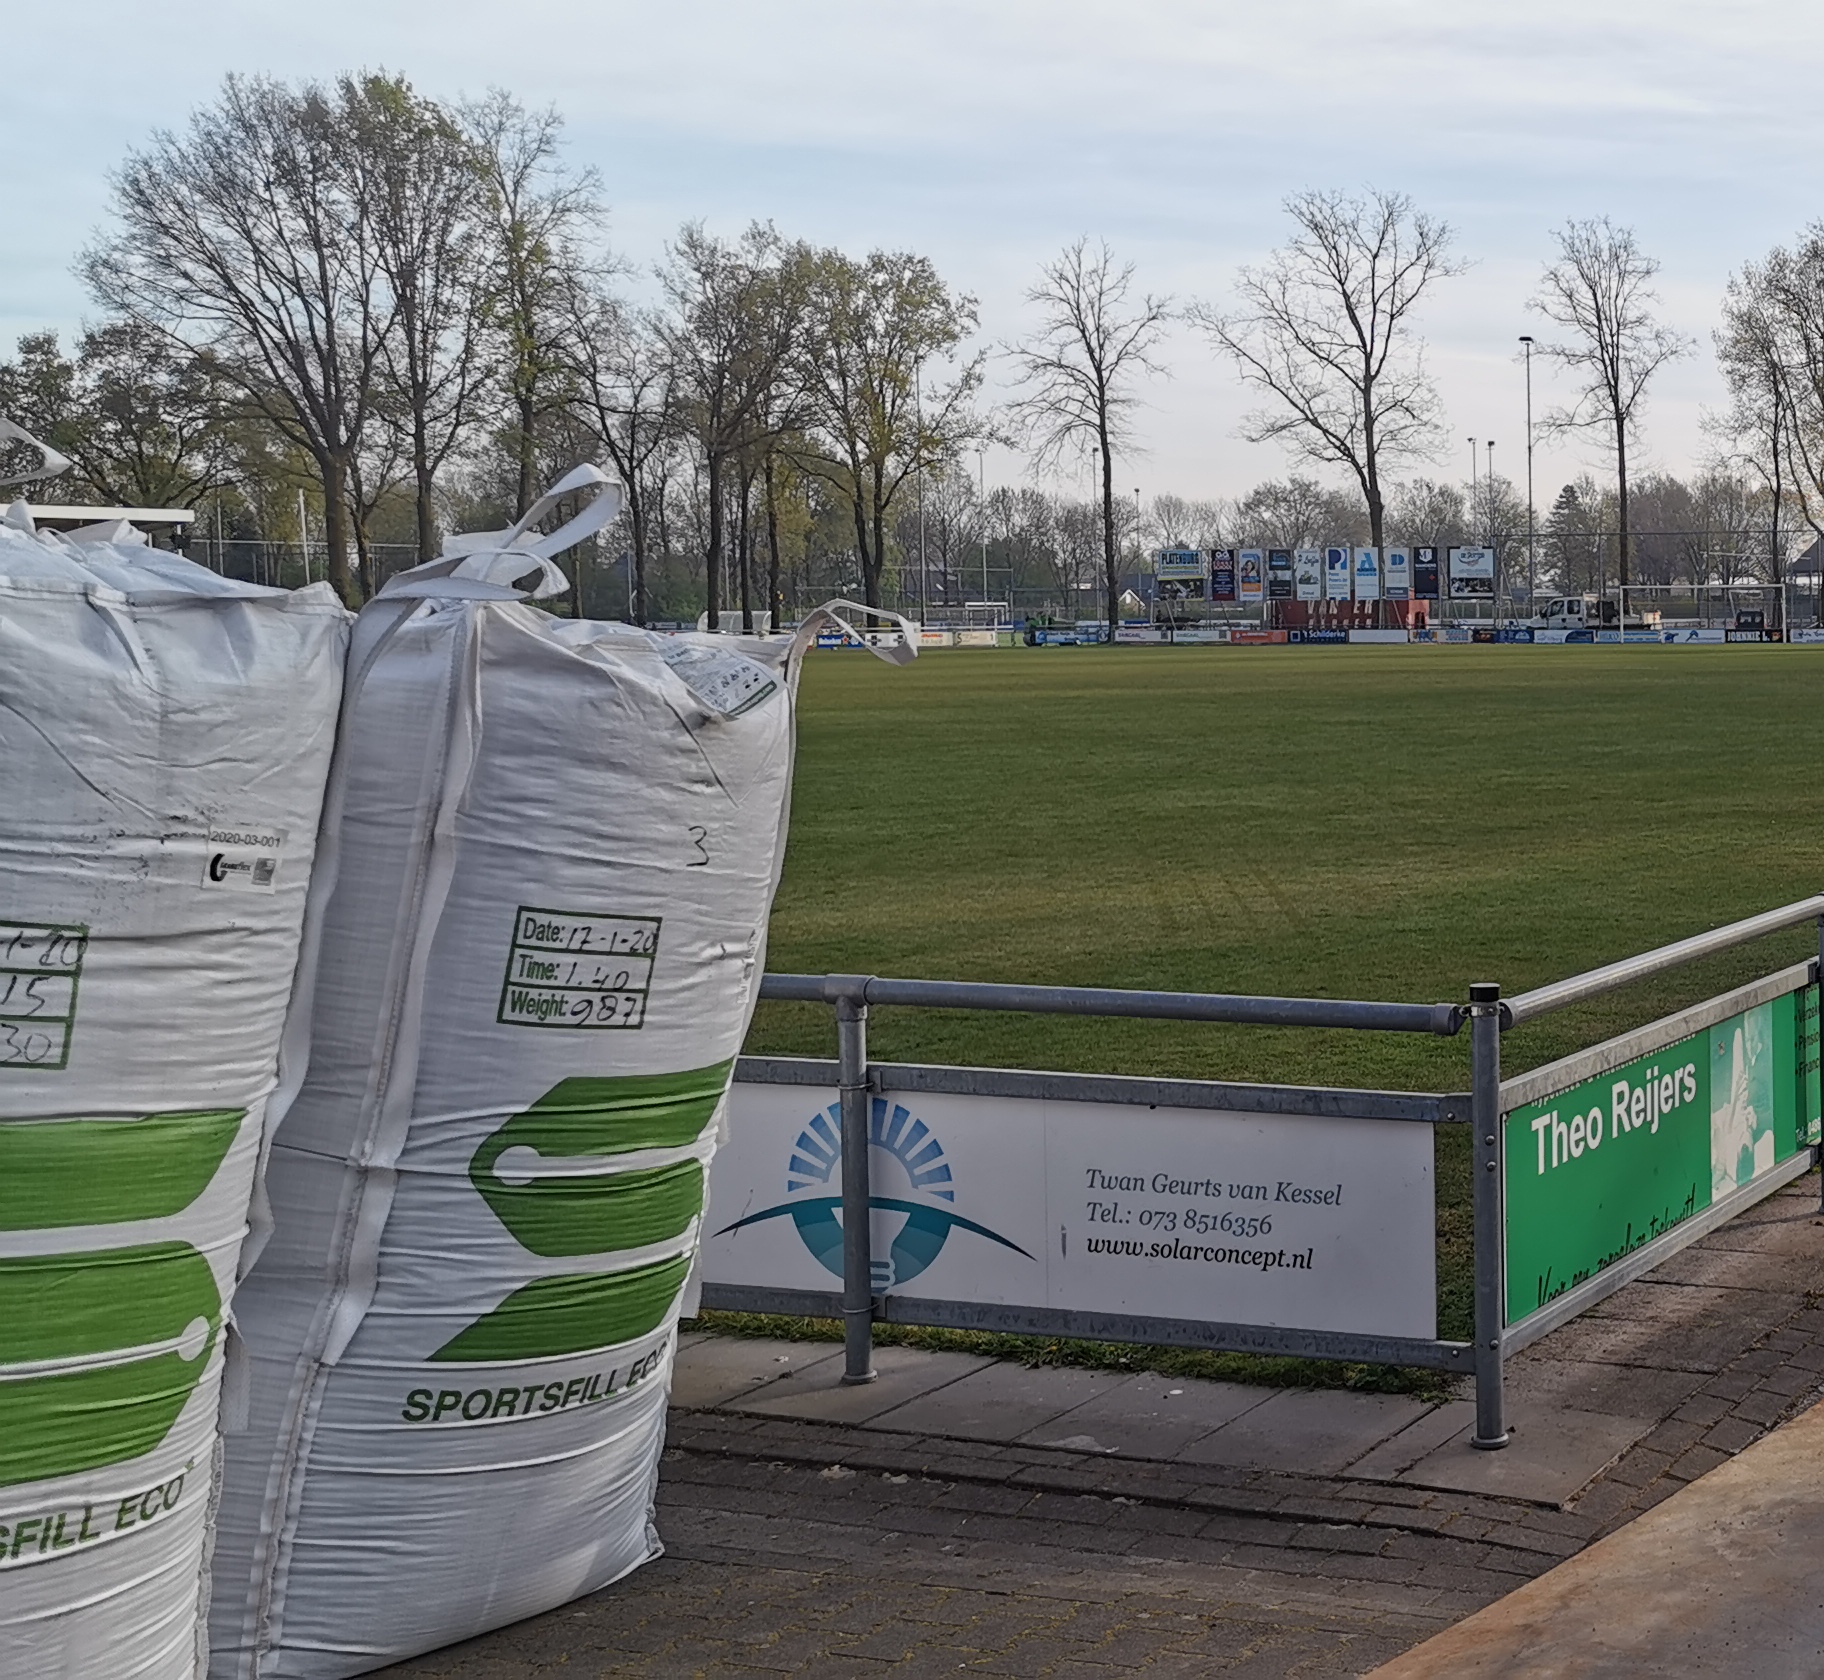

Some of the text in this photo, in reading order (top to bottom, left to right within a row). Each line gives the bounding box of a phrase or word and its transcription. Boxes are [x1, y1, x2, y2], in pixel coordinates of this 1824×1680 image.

[210, 830, 281, 848] 2020-03-001
[686, 825, 710, 867] 3
[523, 917, 566, 944] Date:
[517, 954, 561, 982] Time:
[510, 989, 570, 1022] Weight:
[1531, 1106, 1604, 1176] Theo
[1611, 1062, 1697, 1139] Reijers
[1086, 1168, 1343, 1206] Twan Geurts van Kessel
[1086, 1201, 1273, 1239] Tel.: 073 8516356
[1086, 1237, 1314, 1272] www.solarconcept.nl
[401, 1369, 618, 1422] SPORTSFILL
[115, 1472, 185, 1533] ECO
